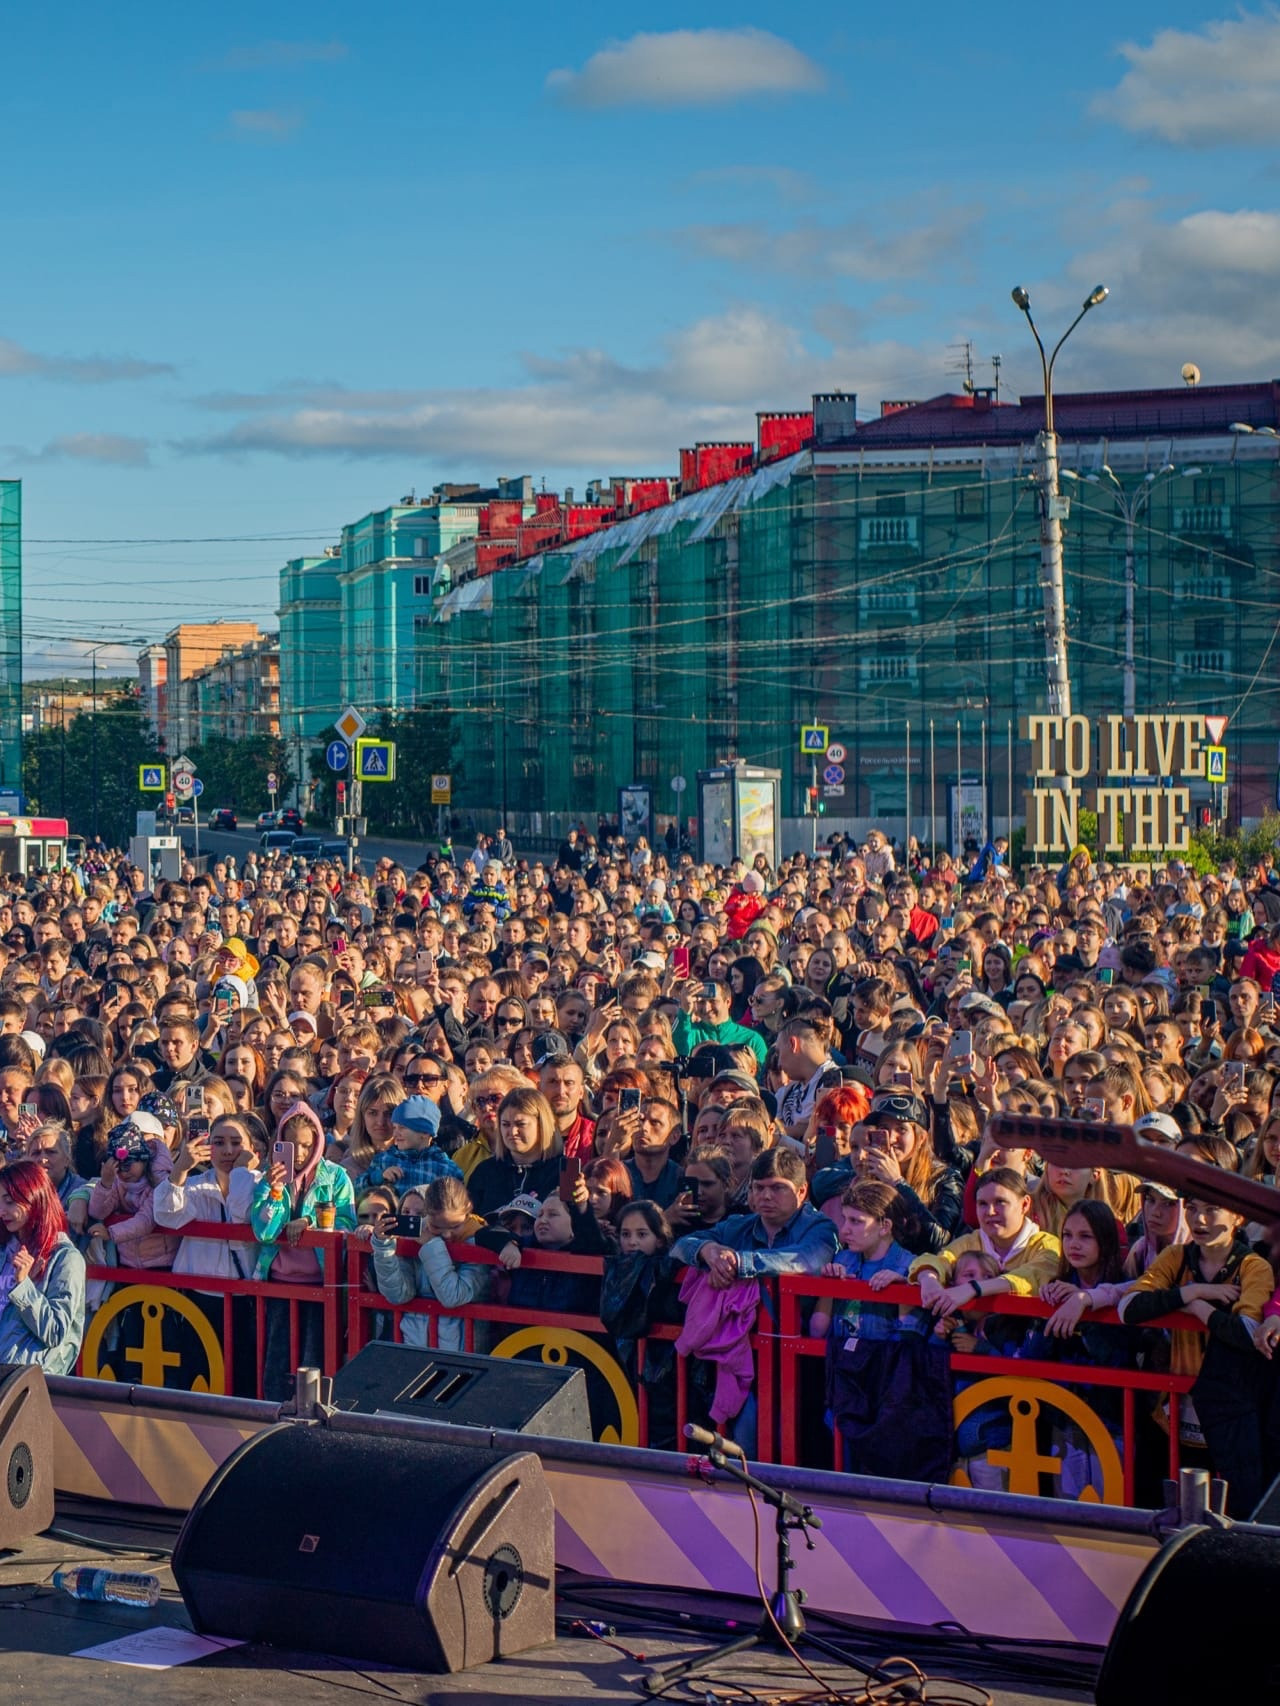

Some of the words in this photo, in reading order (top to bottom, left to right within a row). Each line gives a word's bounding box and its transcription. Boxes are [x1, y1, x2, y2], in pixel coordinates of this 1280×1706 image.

[830, 749, 842, 758] 40
[1028, 714, 1090, 778] TO
[1107, 714, 1206, 777] LIVE
[179, 777, 190, 785] 40
[1033, 788, 1081, 852] IN
[1097, 788, 1190, 852] THE
